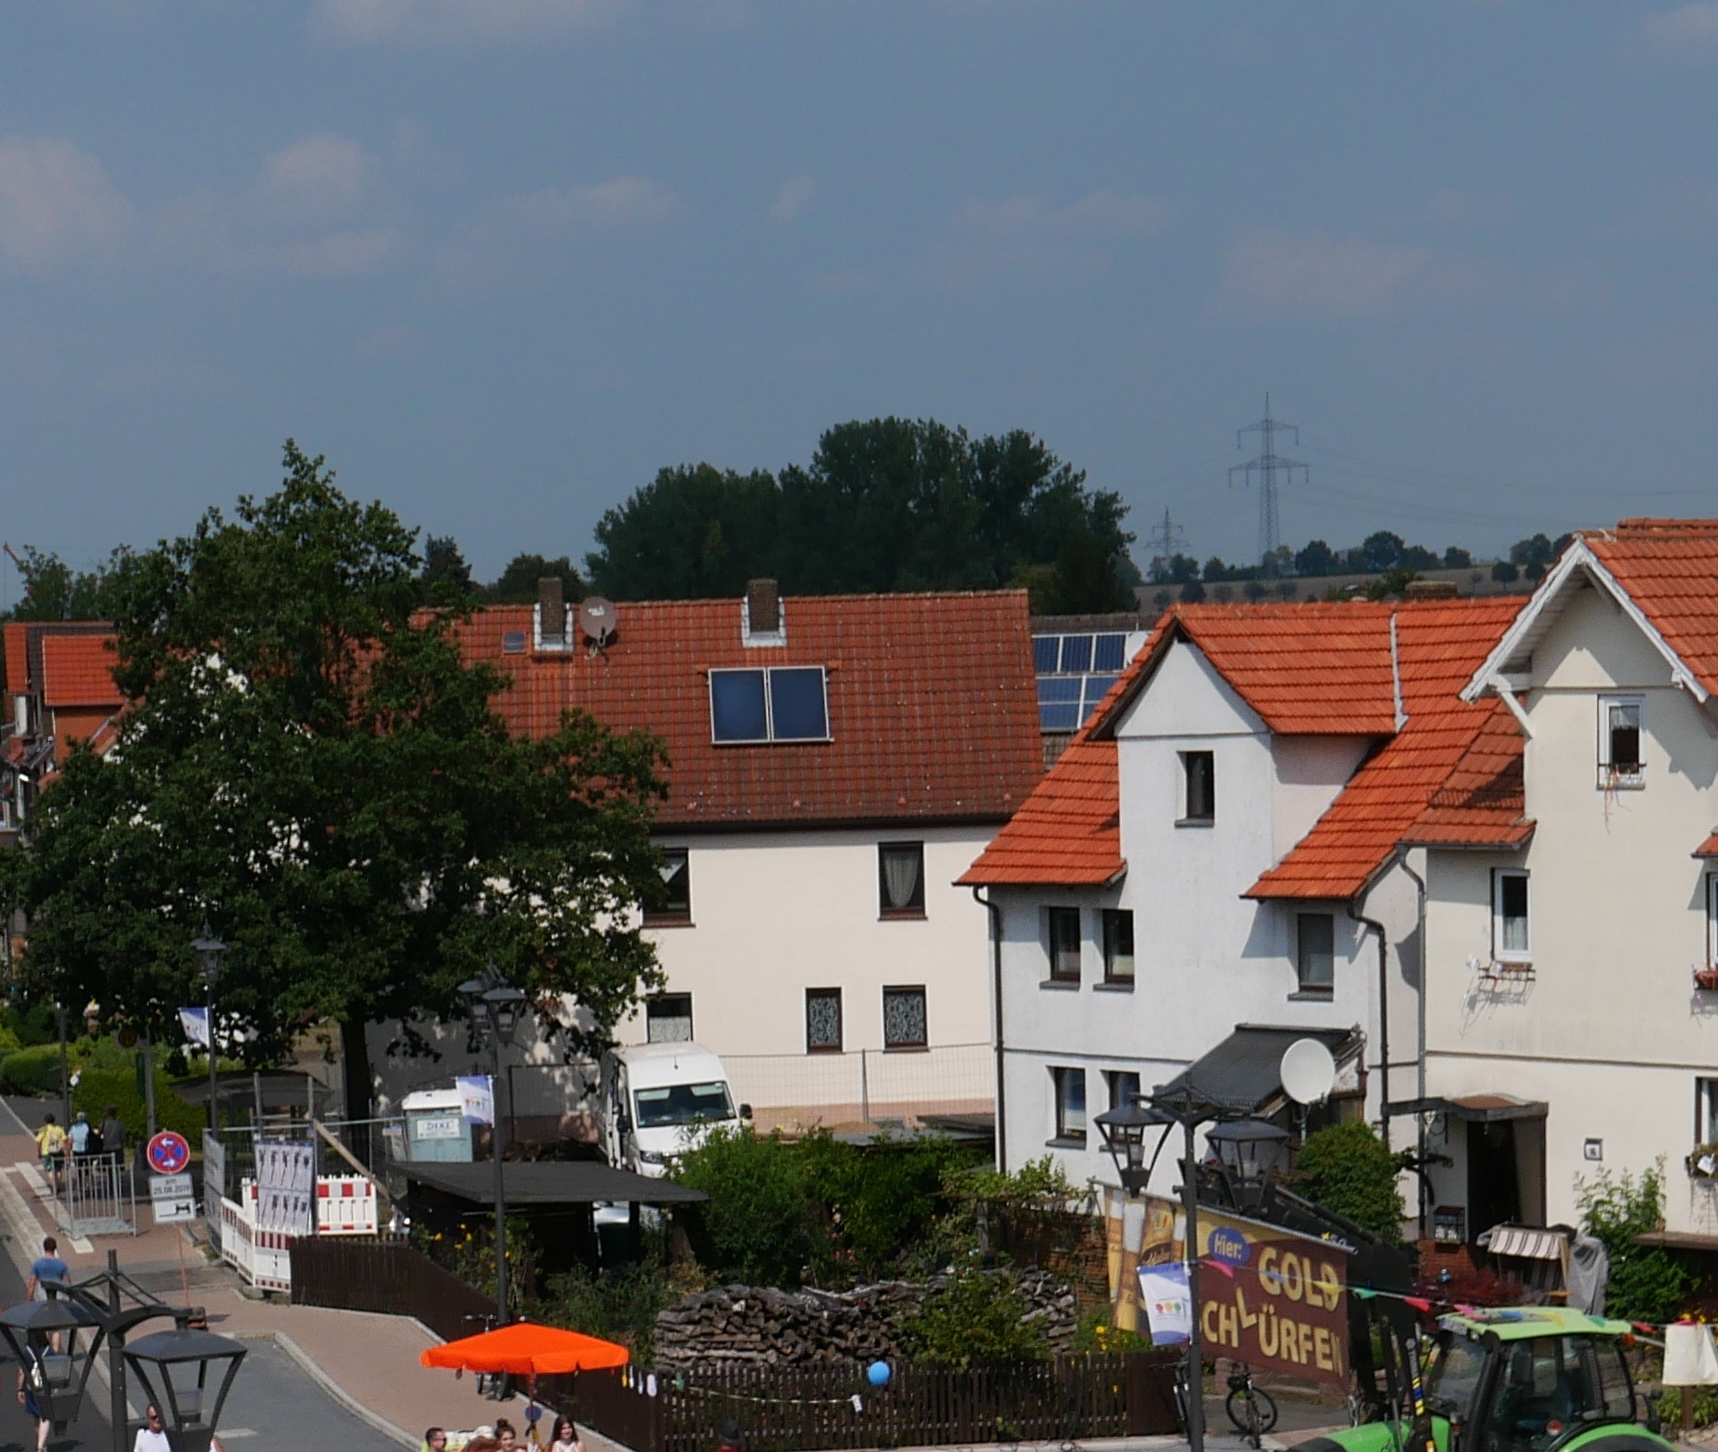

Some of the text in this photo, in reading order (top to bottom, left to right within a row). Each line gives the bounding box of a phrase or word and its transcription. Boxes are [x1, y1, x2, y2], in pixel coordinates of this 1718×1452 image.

[1214, 1233, 1243, 1260] Hier:
[1258, 1246, 1340, 1312] GOLD
[1199, 1287, 1345, 1378] CHLÜRFEN
